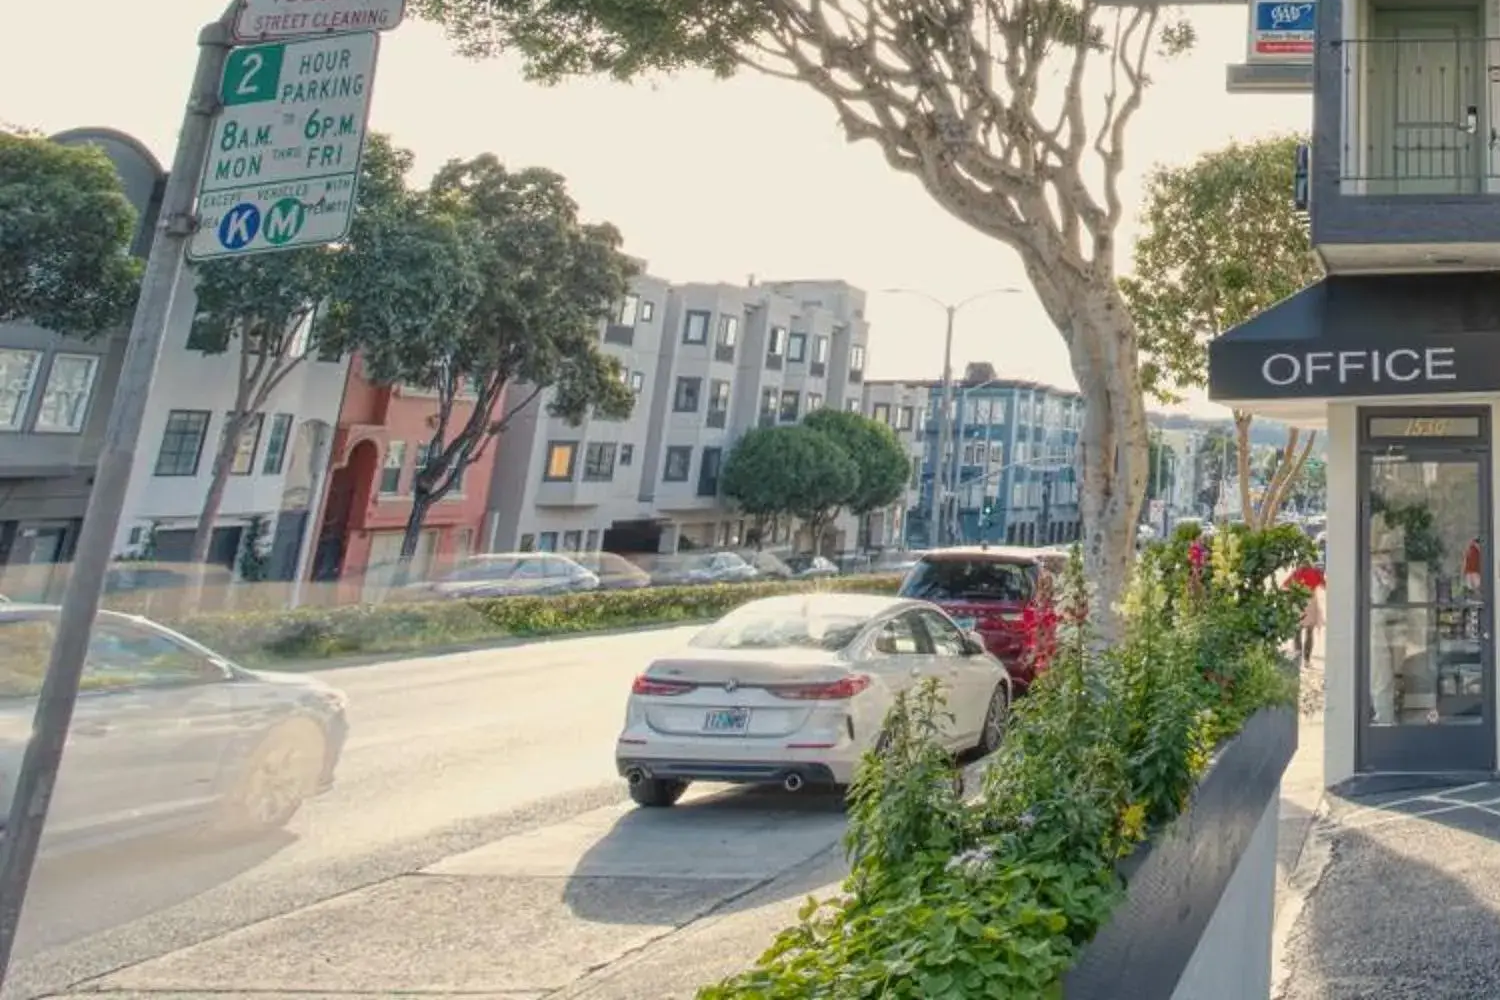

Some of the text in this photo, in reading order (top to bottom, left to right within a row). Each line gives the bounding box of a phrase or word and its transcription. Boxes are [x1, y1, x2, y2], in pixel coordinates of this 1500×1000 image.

[255, 9, 390, 31] STREET CLEANING
[236, 49, 351, 95] 2 HOUR
[281, 74, 365, 104] PARKING
[215, 154, 263, 180] MON
[306, 143, 343, 169] FRI
[226, 209, 254, 244] K
[267, 204, 299, 239] M
[1262, 348, 1457, 386] OFFICE
